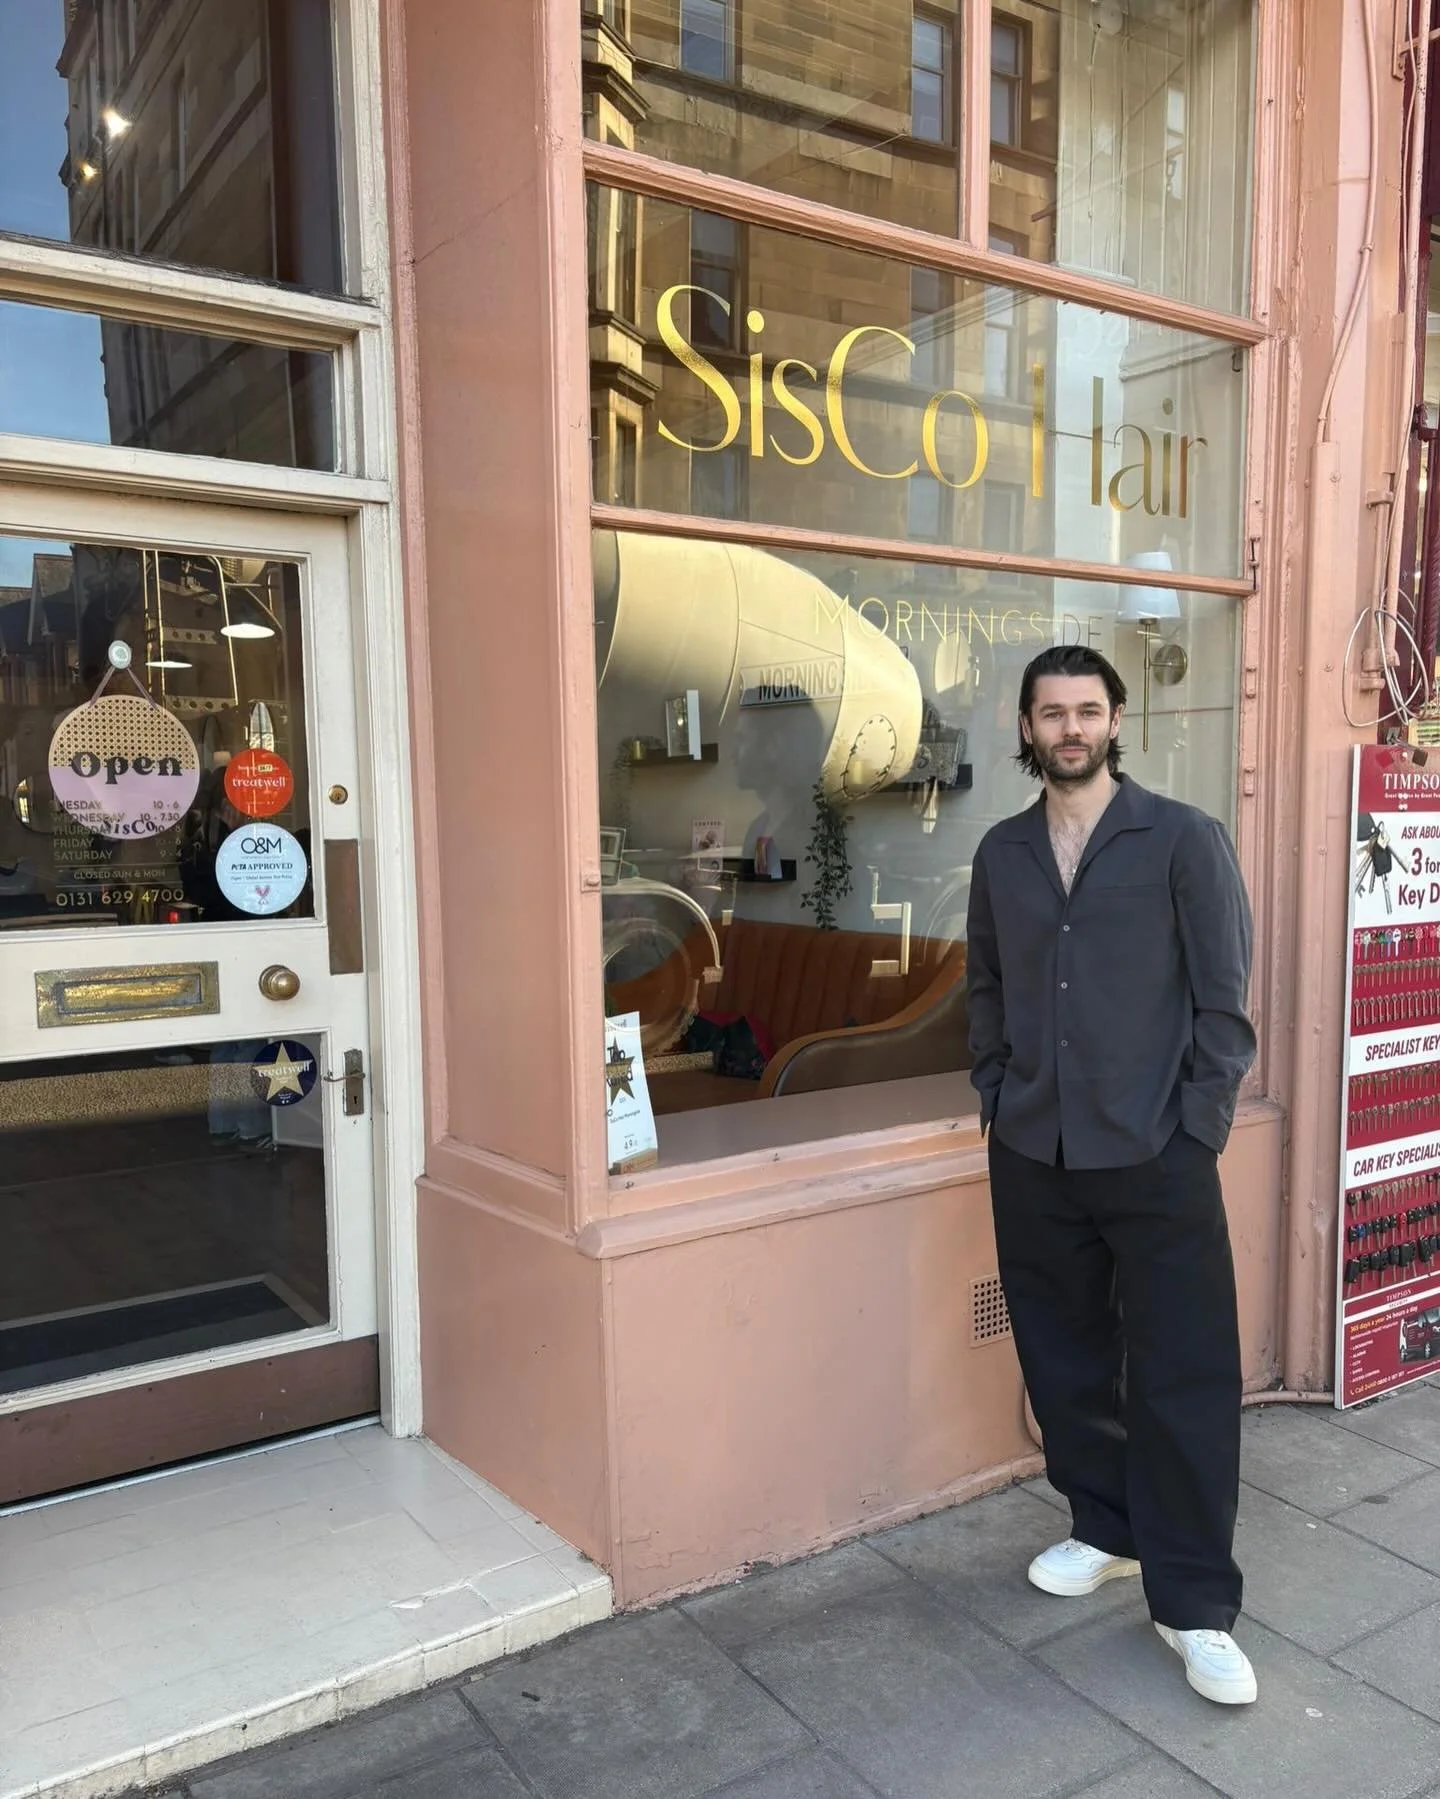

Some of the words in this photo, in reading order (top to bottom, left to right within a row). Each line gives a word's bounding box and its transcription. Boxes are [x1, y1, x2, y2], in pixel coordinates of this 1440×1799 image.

[656, 284, 989, 489] SisCo
[814, 595, 1103, 652] MORNINGSDE
[71, 751, 183, 785] Open
[232, 776, 286, 788] treatwell
[1383, 773, 1440, 790] TIMPSO
[55, 800, 102, 809] UESDAY
[153, 800, 163, 809] 10
[173, 800, 179, 809] 6
[140, 813, 151, 821] 10
[161, 812, 180, 821] 7.30
[1401, 825, 1418, 839] ASK
[53, 839, 94, 848] FRIDAY
[240, 836, 283, 855] O&M
[53, 850, 113, 861] SATURDAY
[1411, 847, 1423, 876] 3
[248, 861, 293, 870] APPROVED
[73, 871, 110, 880] CLOSED
[113, 870, 131, 878] SUN
[143, 869, 165, 878] MON
[56, 892, 93, 907] 0131
[102, 891, 134, 904] 629
[142, 889, 184, 902] 4700
[1398, 883, 1426, 910] Key
[1365, 1037, 1422, 1062] SPECIALIST
[1353, 1159, 1373, 1177] CAR
[1376, 1152, 1396, 1171] KEY
[1386, 1288, 1412, 1302] TIMPSON
